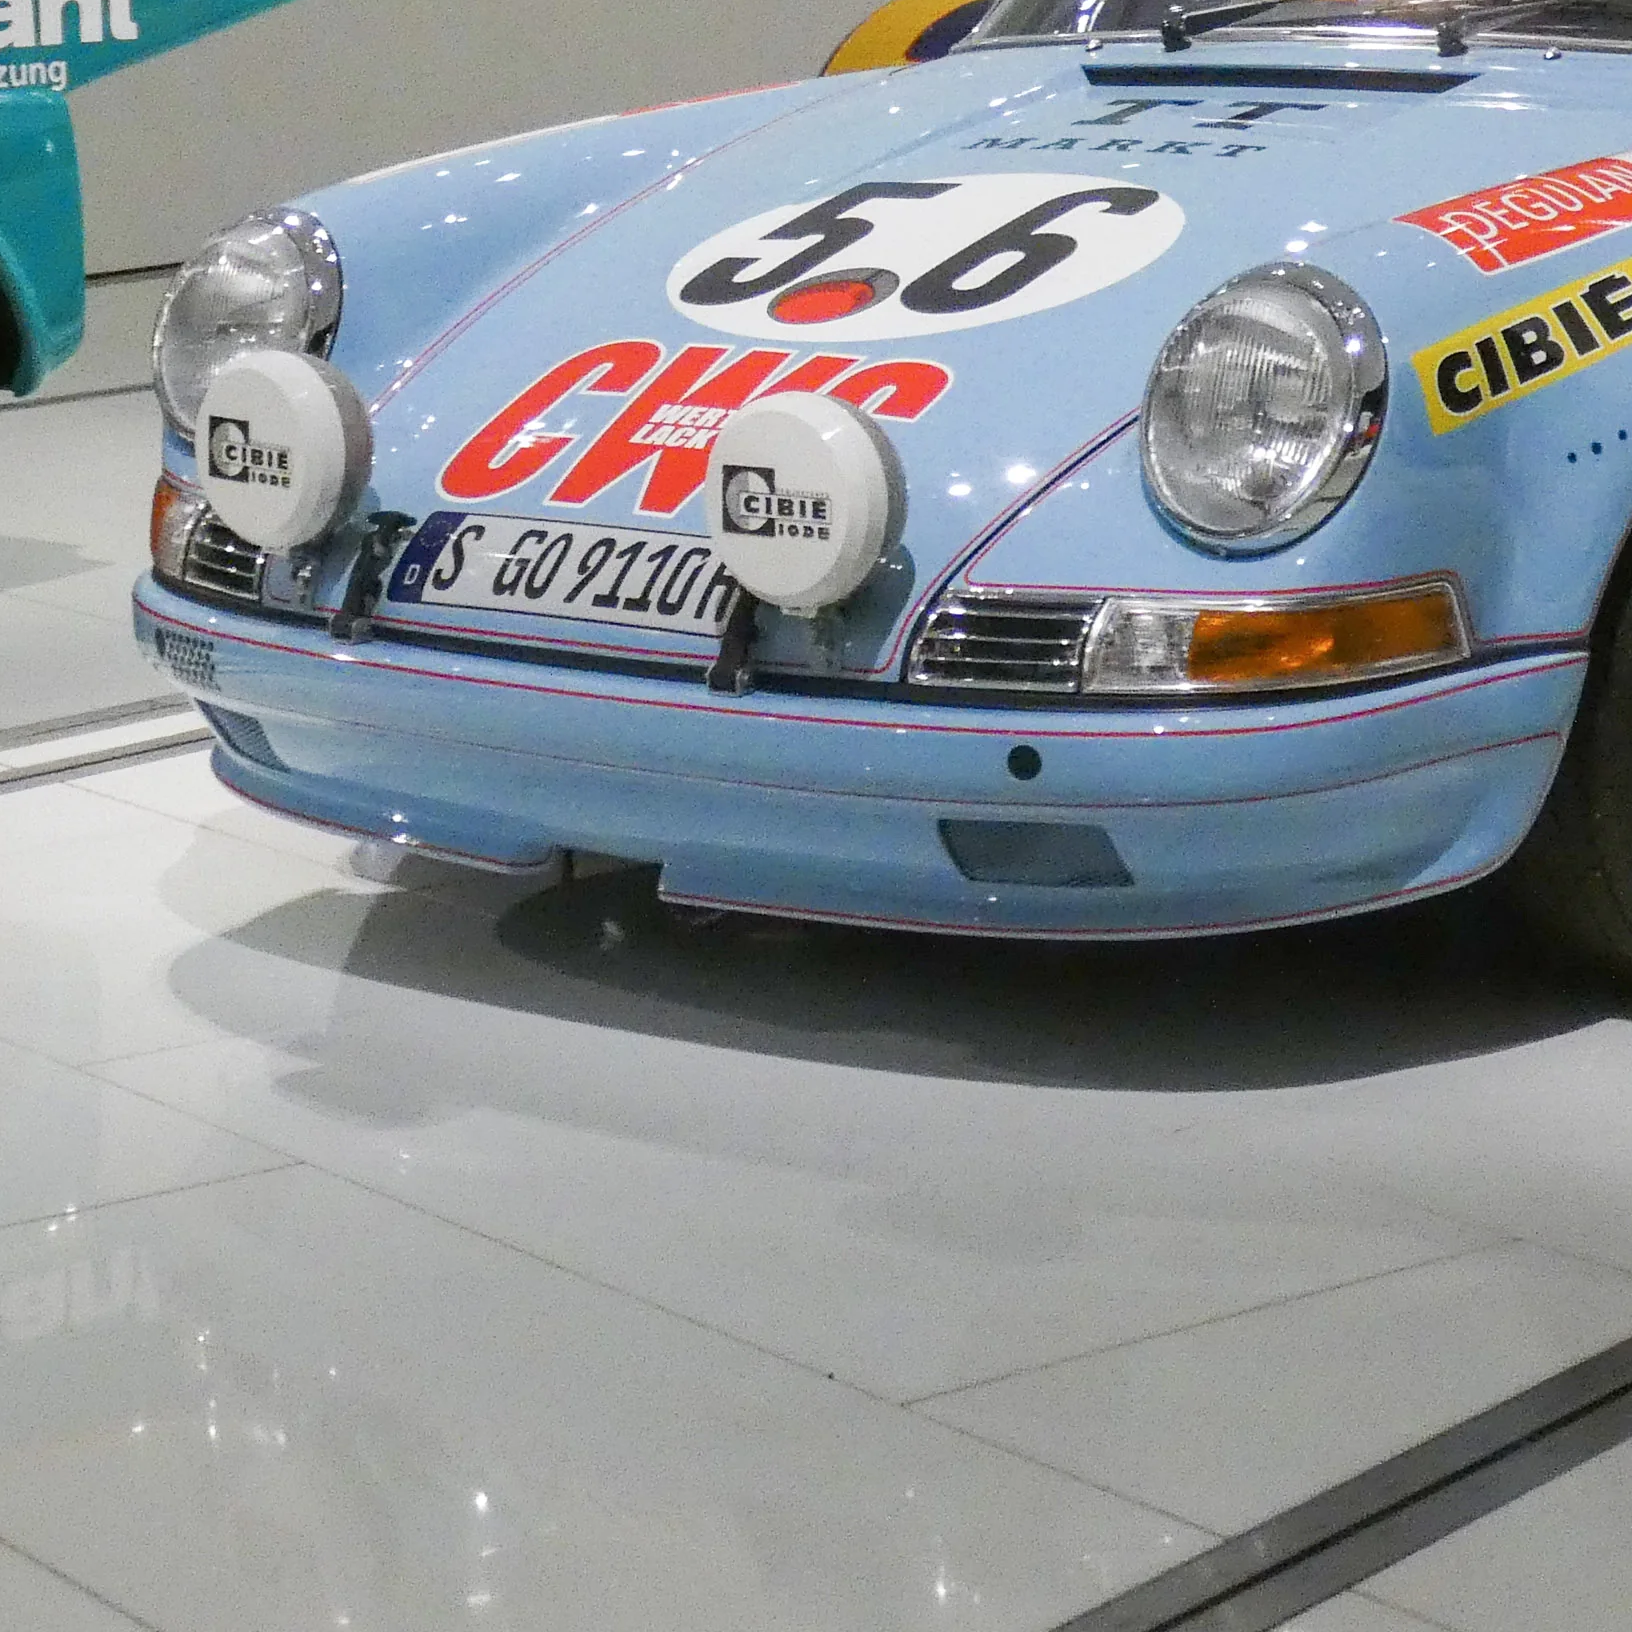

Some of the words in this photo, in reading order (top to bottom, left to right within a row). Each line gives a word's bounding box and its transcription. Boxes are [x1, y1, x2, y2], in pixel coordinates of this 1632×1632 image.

[961, 137, 1268, 158] MARKT
[678, 181, 1161, 315] 56
[629, 423, 719, 450] LACK
[225, 444, 288, 470] CIBIE
[743, 495, 827, 520] CIBIE
[431, 524, 486, 591] S
[403, 564, 420, 585] D
